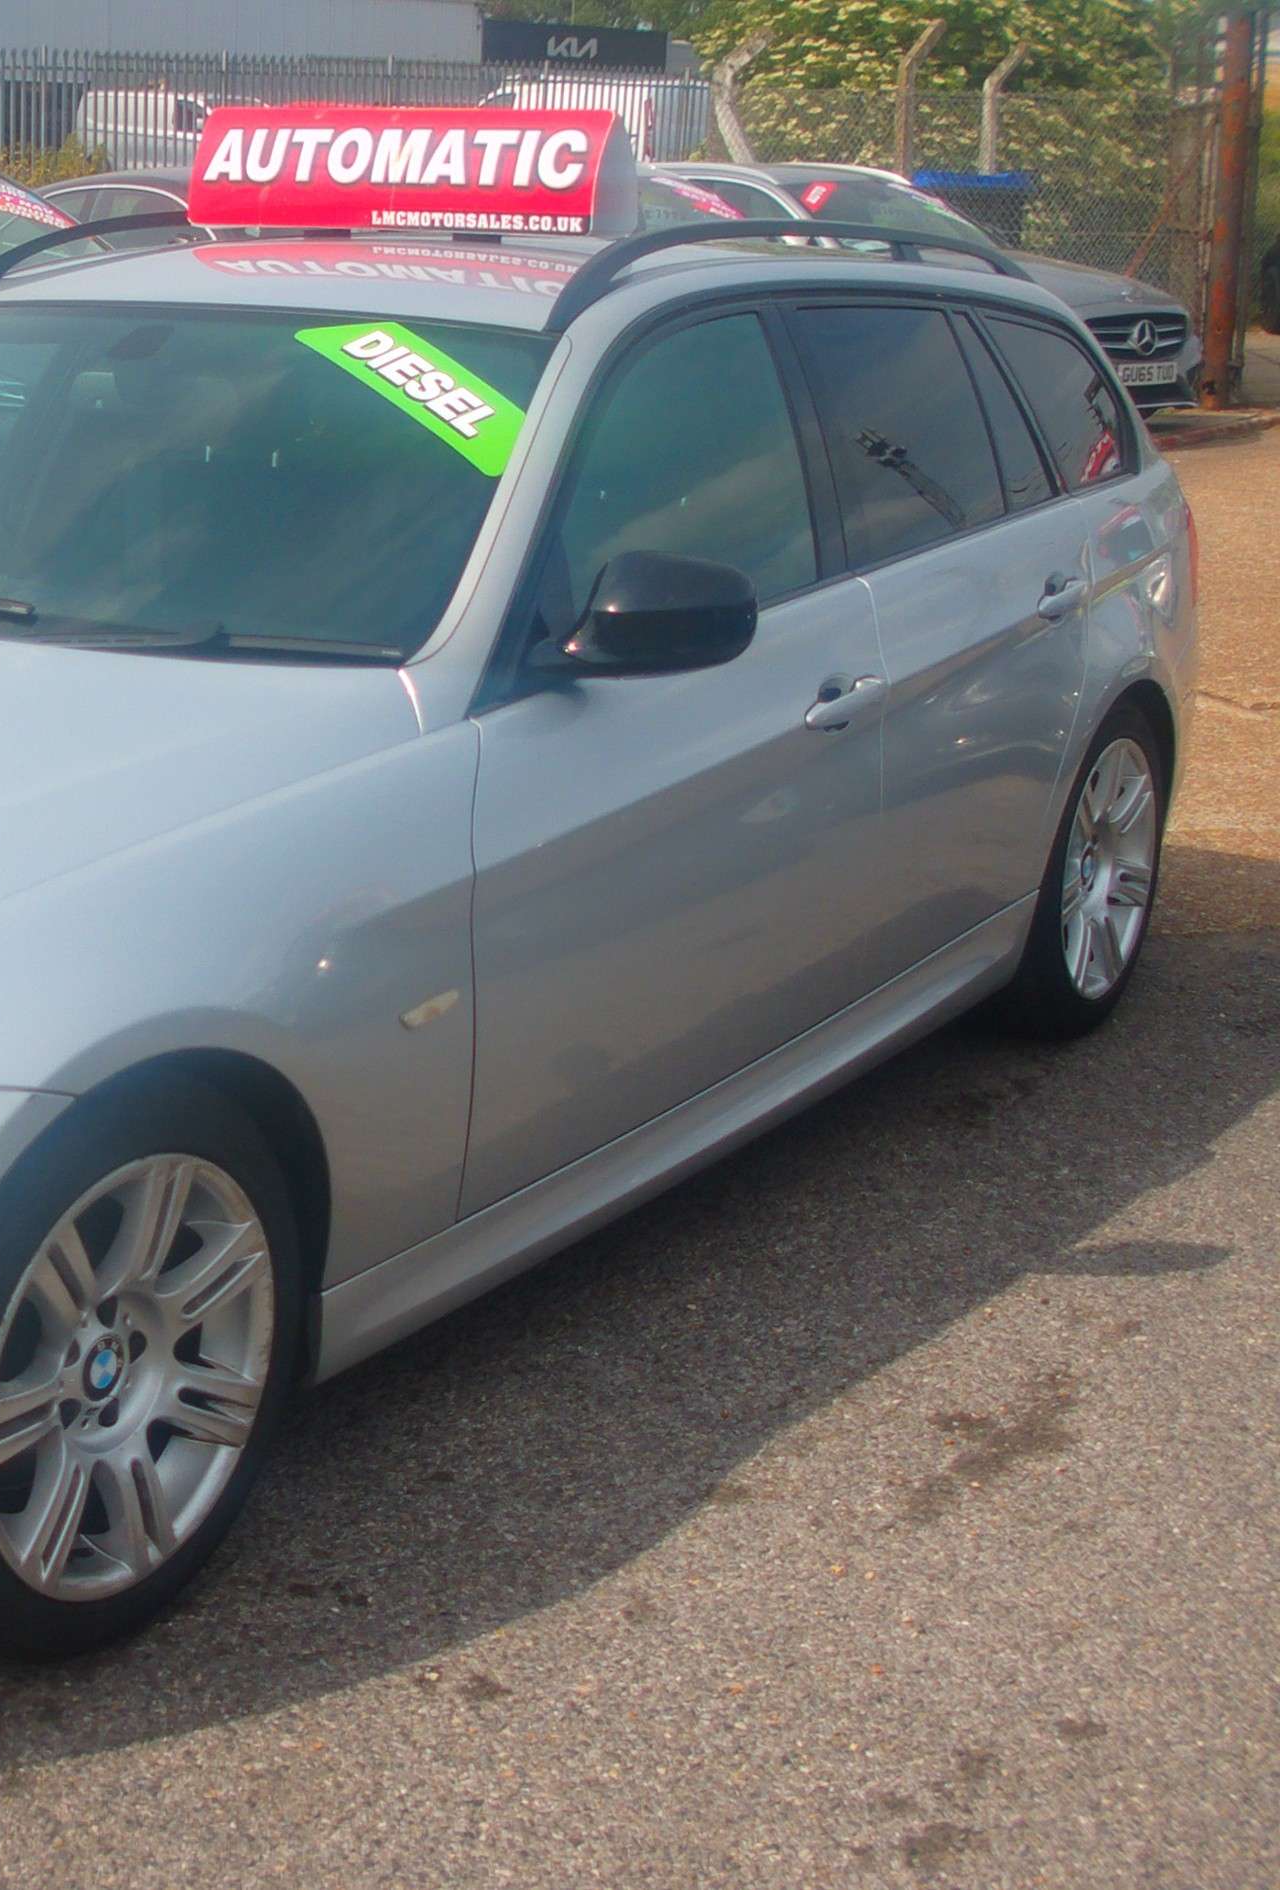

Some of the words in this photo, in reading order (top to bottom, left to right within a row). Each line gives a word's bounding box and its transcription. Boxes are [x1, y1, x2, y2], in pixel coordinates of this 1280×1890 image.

[202, 128, 588, 190] AUTOMATIC
[371, 210, 582, 233] LMCMOTORSALES.CO.UK
[341, 330, 496, 440] DIESEL
